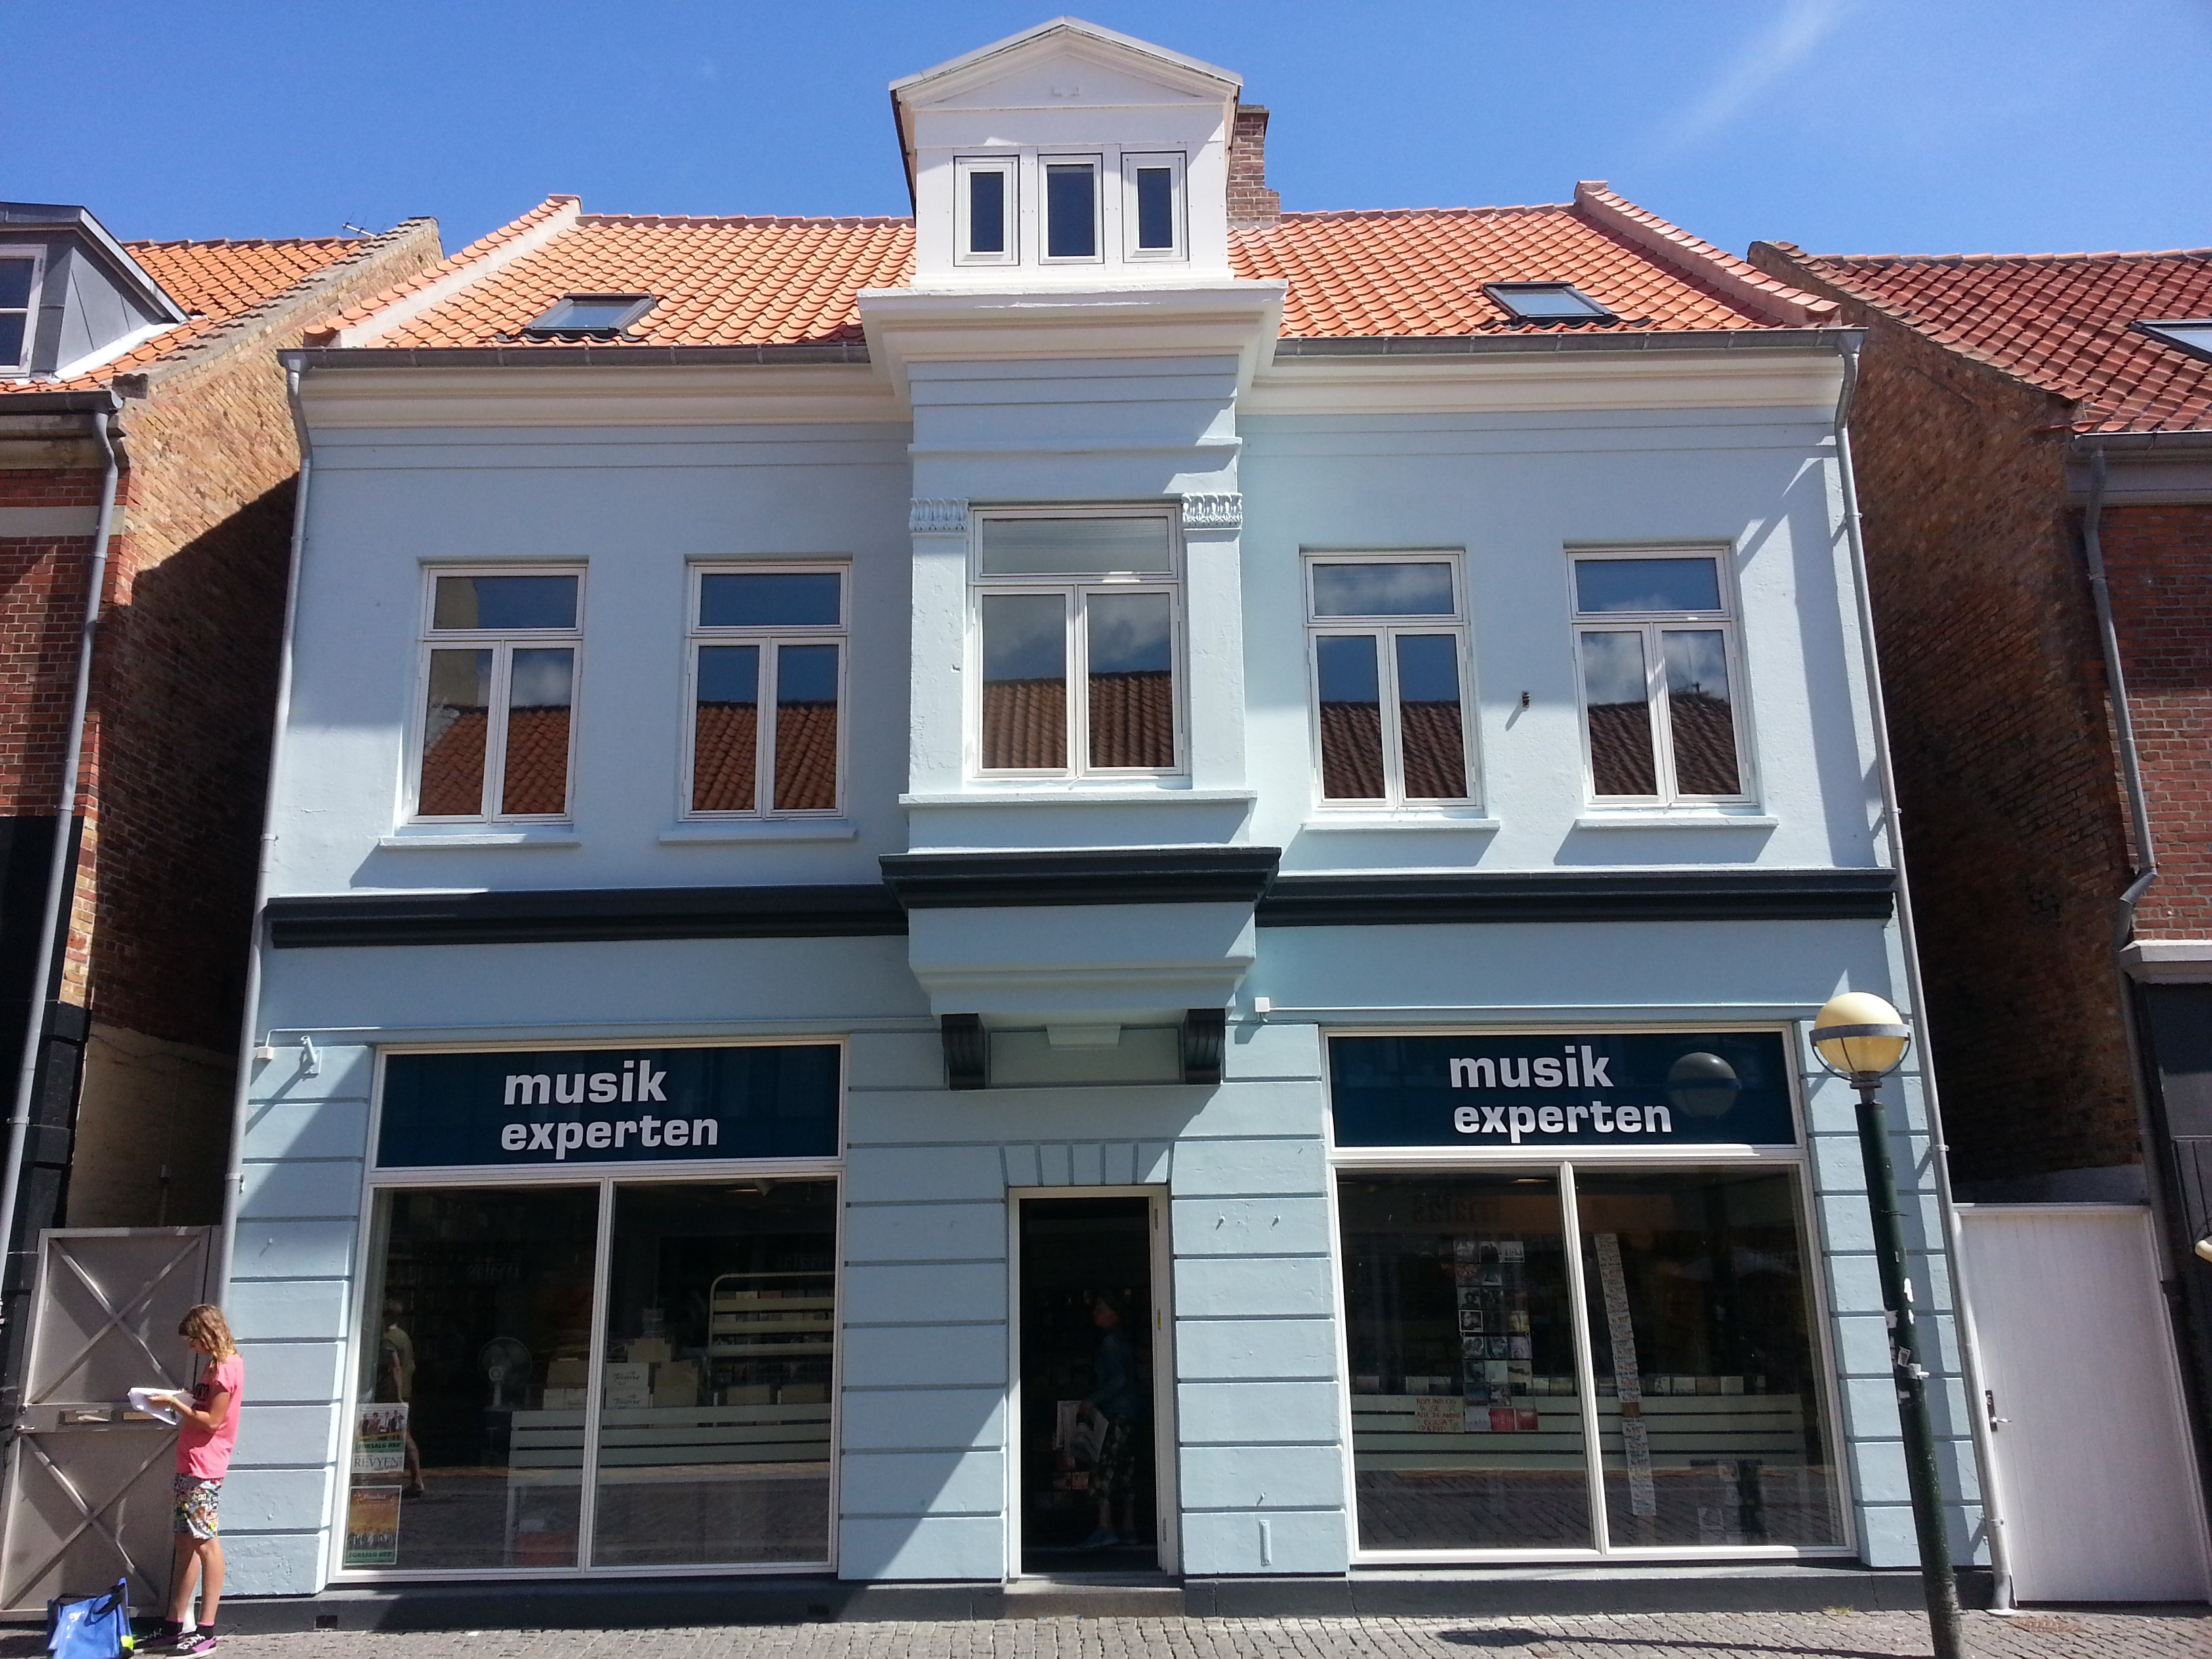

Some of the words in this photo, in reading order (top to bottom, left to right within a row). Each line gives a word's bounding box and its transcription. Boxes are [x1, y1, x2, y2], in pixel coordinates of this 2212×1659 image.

[504, 1060, 668, 1105] musik
[1449, 1045, 1614, 1088] musik
[501, 1115, 718, 1160] experten
[1454, 1101, 1672, 1144] experten
